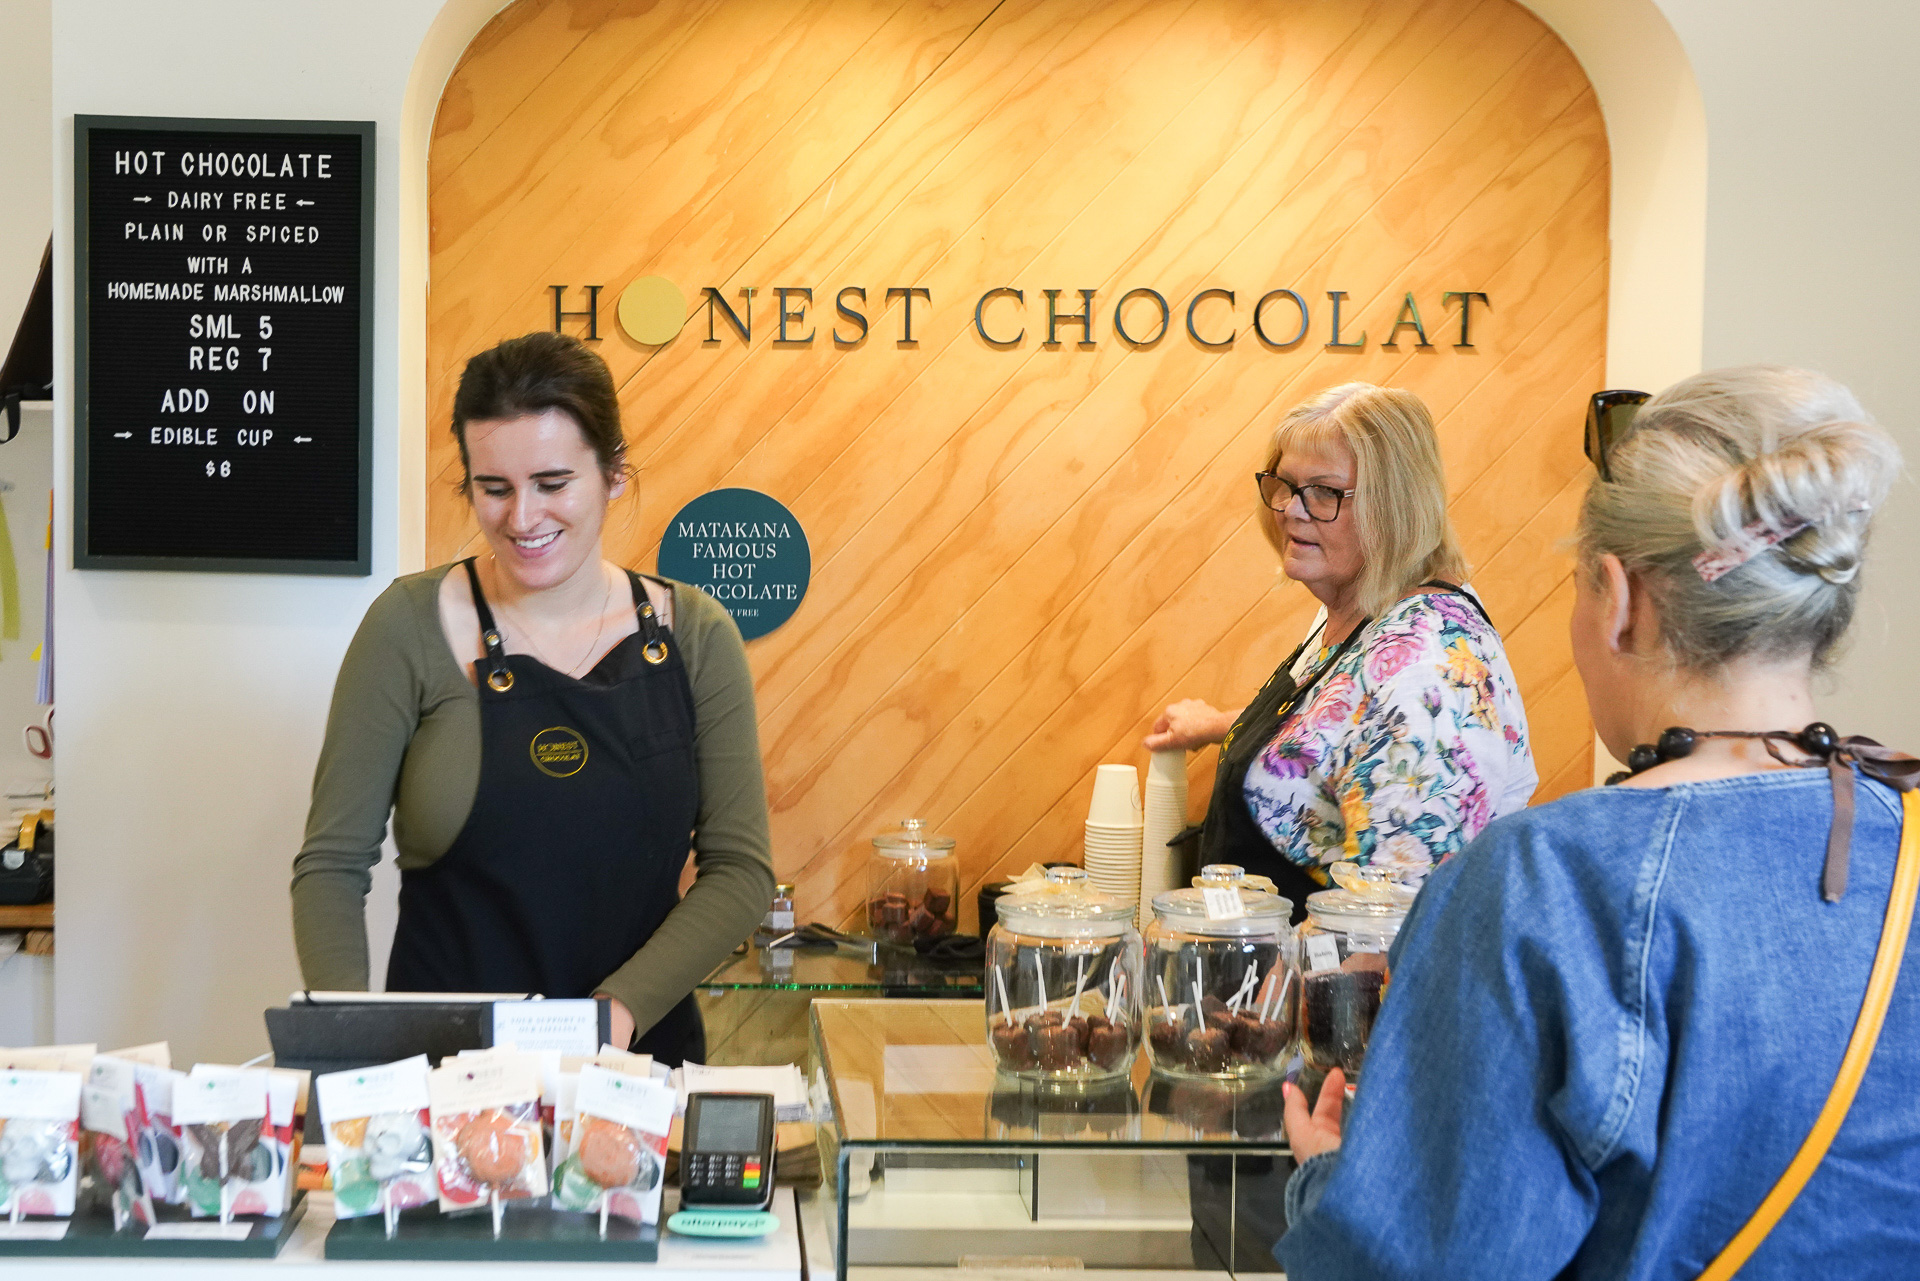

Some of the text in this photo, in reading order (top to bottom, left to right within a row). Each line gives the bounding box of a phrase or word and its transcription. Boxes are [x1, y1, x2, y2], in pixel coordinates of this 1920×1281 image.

[115, 150, 332, 179] HOT CHOCOLATE
[168, 190, 286, 211] DAIRY FREE
[125, 221, 319, 244] PLAIN OR SPICED
[187, 256, 252, 275] WITH A
[108, 281, 345, 304] HOMEMADE MARSHMALLOW
[189, 313, 273, 340] SML 5
[974, 287, 1491, 347] CHOCOLAT
[189, 346, 272, 372] REG 7
[160, 388, 275, 415] ADD ON
[150, 426, 274, 447] EDIBLE CUP
[678, 522, 791, 538] MATAKANA
[693, 543, 777, 559] FAMOUS
[712, 563, 757, 579] HOT
[692, 584, 798, 600] OCOLATE
[737, 608, 760, 617] FREE
